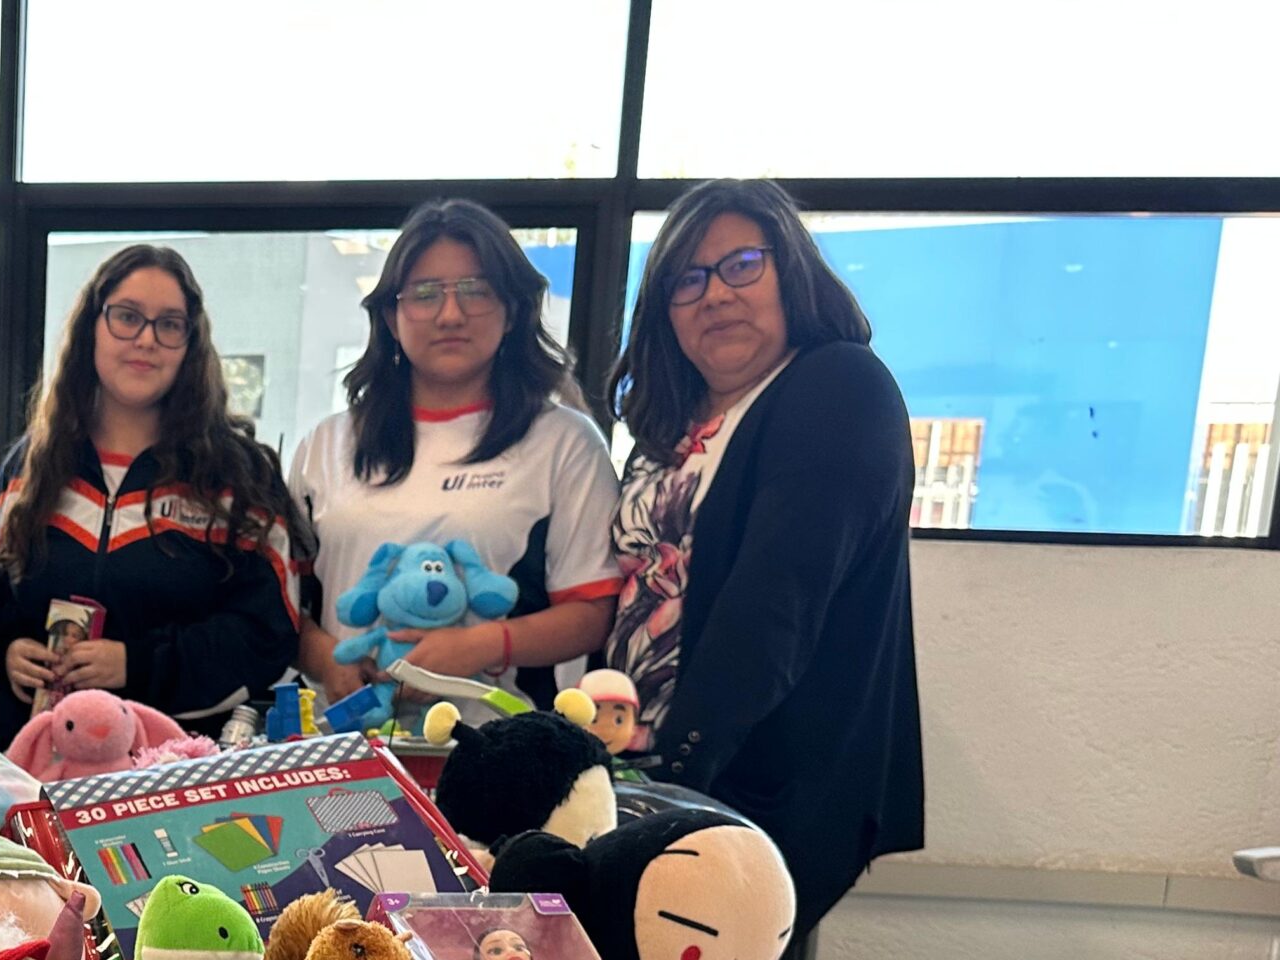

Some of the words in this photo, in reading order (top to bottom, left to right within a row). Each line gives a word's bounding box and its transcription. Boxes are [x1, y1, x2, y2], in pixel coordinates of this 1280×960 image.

[75, 809, 107, 825] 30
[112, 794, 181, 817] PIECE
[184, 784, 227, 803] SET
[234, 766, 352, 793] INCLUDES:
